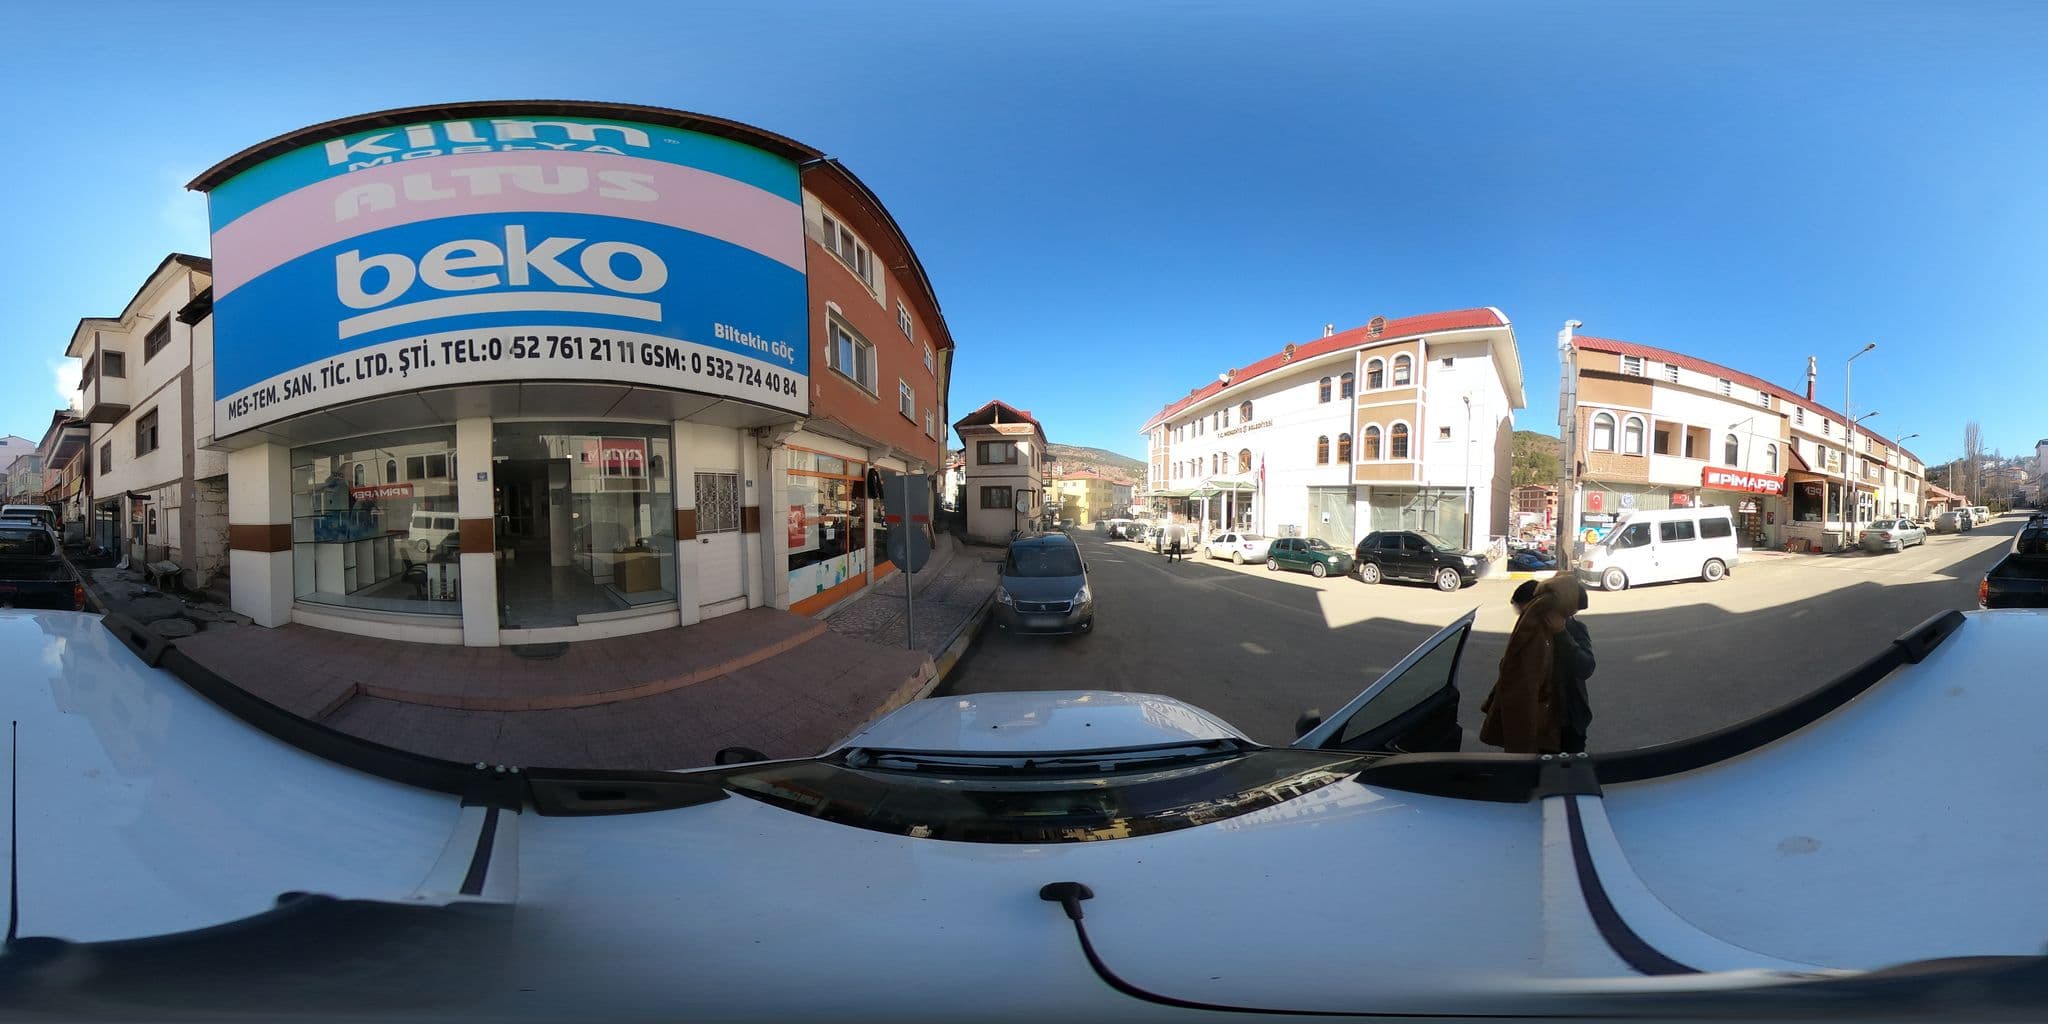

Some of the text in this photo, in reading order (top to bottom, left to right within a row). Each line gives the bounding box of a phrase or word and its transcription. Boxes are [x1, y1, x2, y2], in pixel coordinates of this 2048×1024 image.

[335, 165, 660, 223] ALTUS
[335, 225, 668, 309] beko
[228, 385, 280, 420] MES-TEM.
[283, 372, 316, 400] SAN.
[320, 360, 350, 388] TİC.
[356, 353, 393, 380] LTD.
[399, 339, 435, 377] ŞTİ.
[509, 335, 540, 359] 52
[546, 336, 583, 359] 761
[589, 337, 612, 361] 21
[617, 340, 635, 363] 11
[641, 343, 686, 371] GSM:
[691, 352, 701, 374] 0
[706, 356, 734, 381] 532
[737, 363, 762, 388] 724
[765, 372, 780, 392] 40
[783, 377, 798, 397] 84
[714, 322, 795, 364] Biltekin GÖÇ
